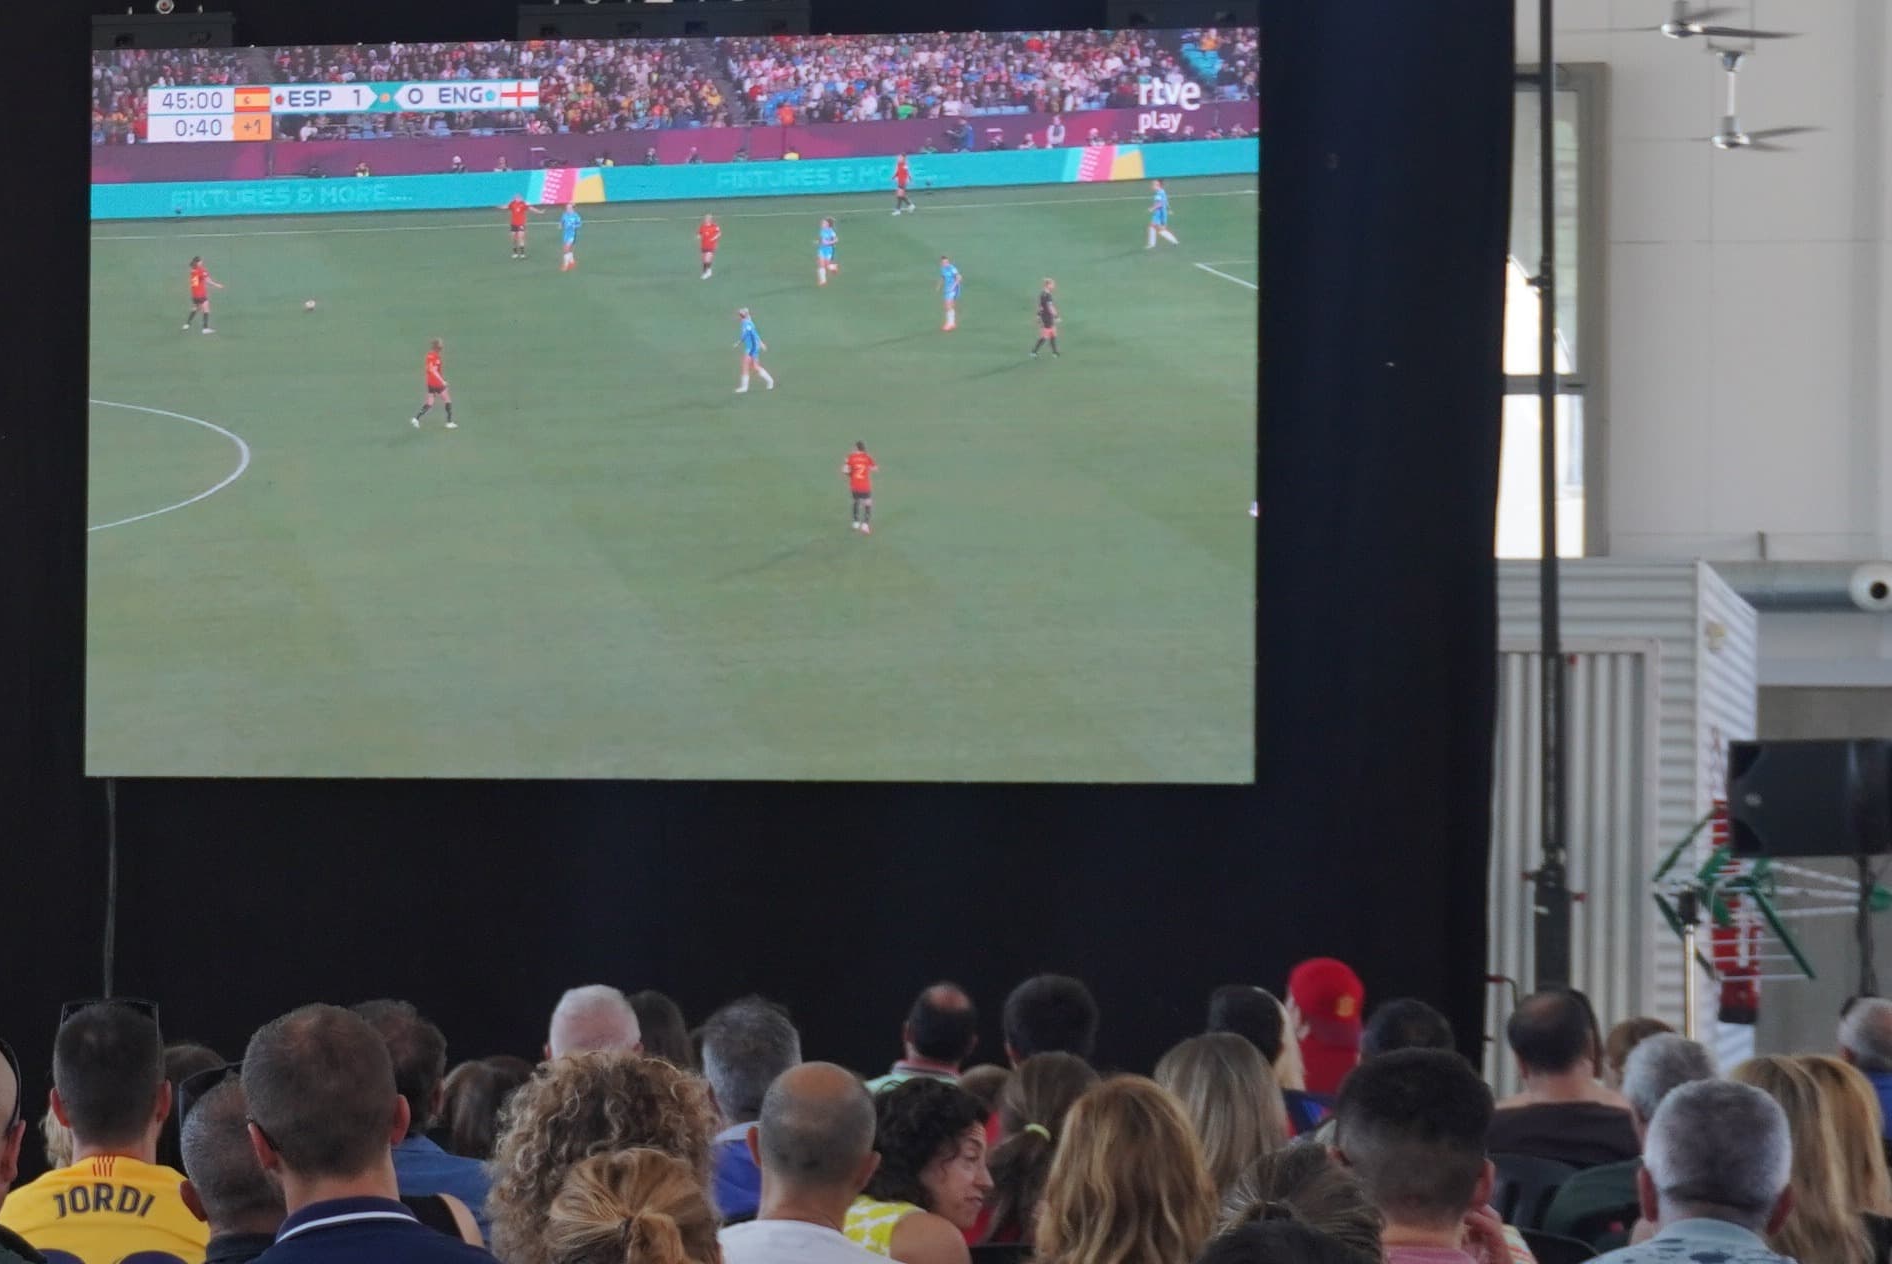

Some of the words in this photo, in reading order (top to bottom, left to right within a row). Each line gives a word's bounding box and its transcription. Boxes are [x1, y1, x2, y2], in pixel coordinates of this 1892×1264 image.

[162, 91, 223, 110] 45:00
[288, 90, 332, 107] ESP
[352, 89, 362, 106] 1
[438, 86, 483, 105] ENG
[1138, 76, 1201, 111] rtve
[175, 119, 222, 137] 0:40
[243, 119, 261, 135] +1
[1138, 110, 1182, 134] play
[53, 1182, 156, 1219] JORDI
